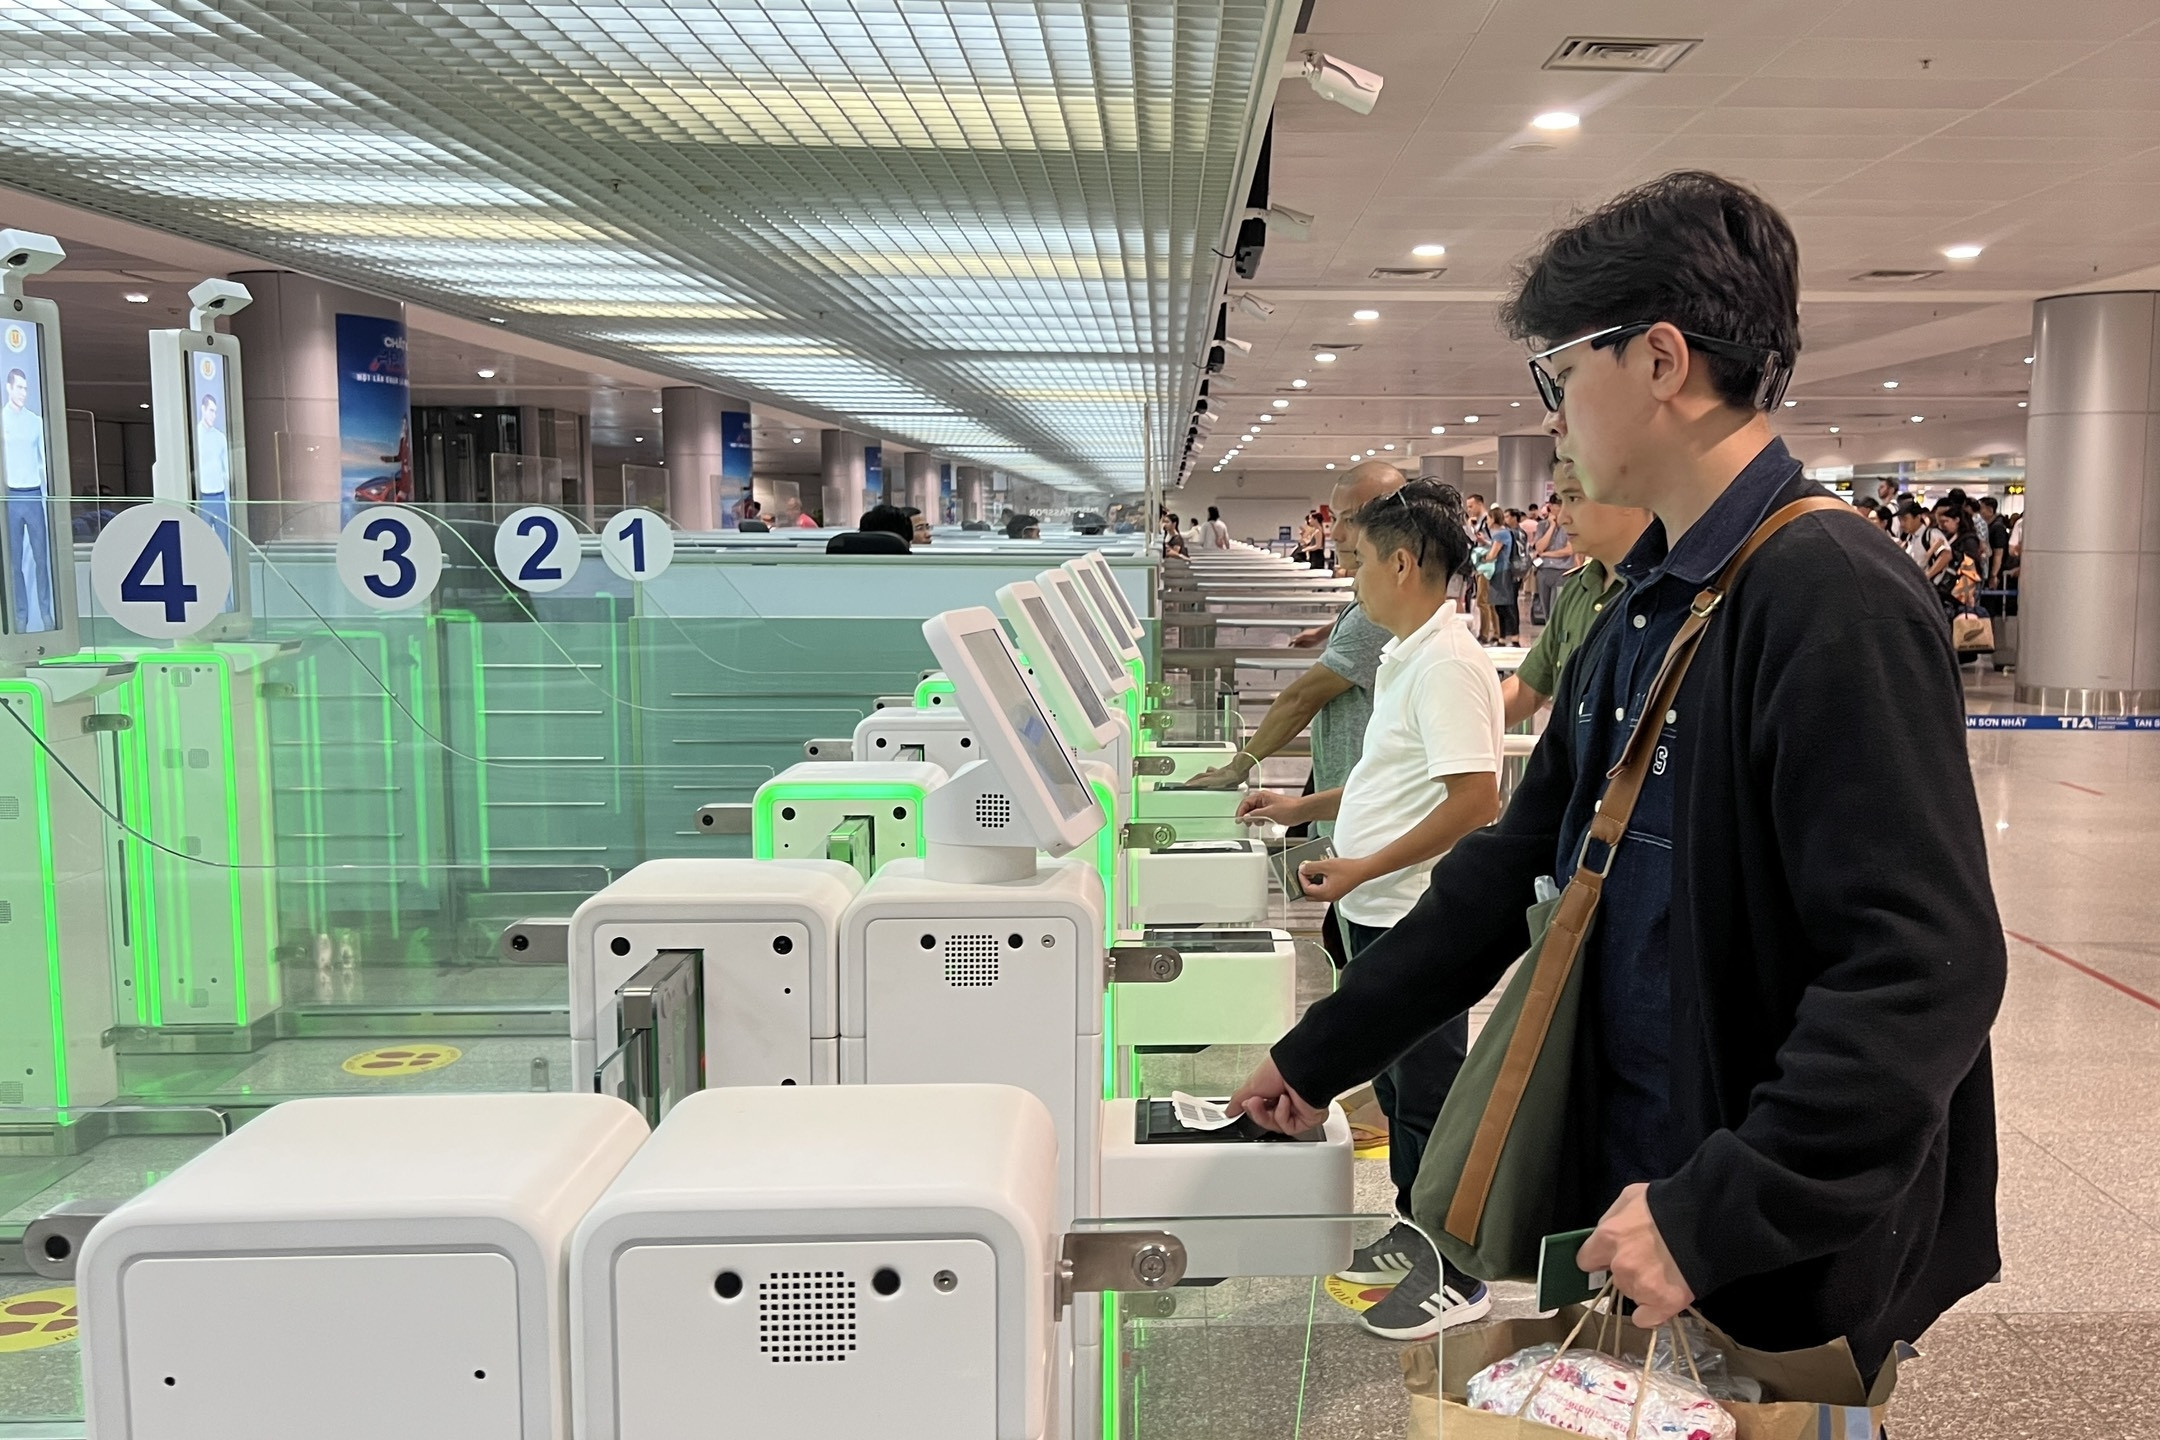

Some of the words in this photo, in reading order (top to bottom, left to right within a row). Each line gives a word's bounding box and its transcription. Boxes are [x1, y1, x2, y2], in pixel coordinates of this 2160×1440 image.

[120, 520, 197, 623] 4
[363, 518, 417, 598] 3
[515, 515, 562, 580] 2
[618, 518, 646, 572] 1
[2058, 717, 2093, 728] TIA
[1653, 745, 1669, 775] S
